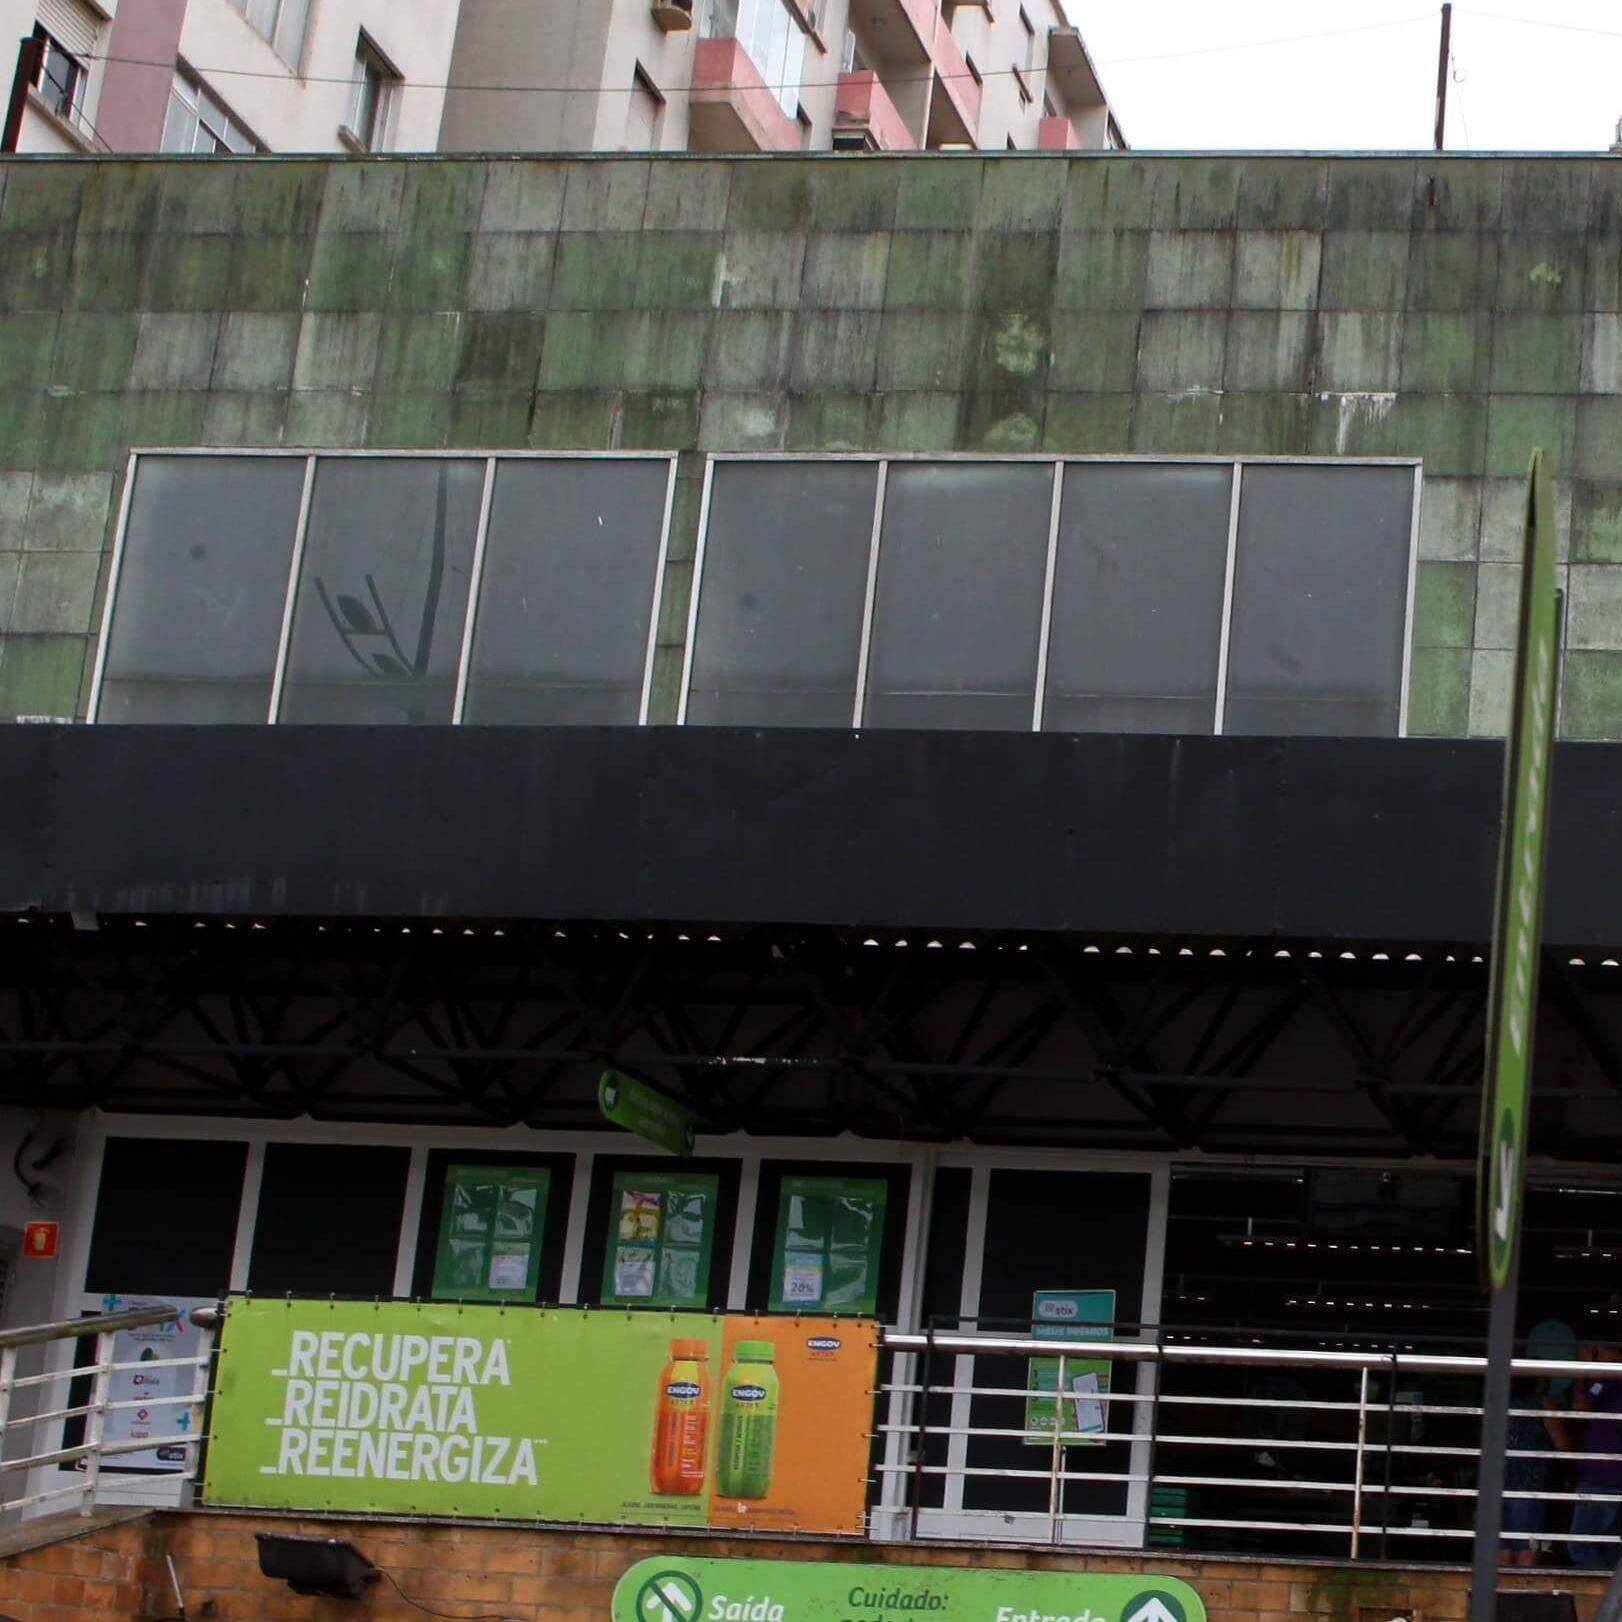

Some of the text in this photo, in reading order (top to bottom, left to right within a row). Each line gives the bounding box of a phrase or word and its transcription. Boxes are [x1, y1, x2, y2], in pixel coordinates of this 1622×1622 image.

[807, 1340, 841, 1349] ENGOV
[667, 1386, 700, 1396] ENGOV
[733, 1389, 766, 1399] ENGOV
[848, 1587, 949, 1610] Cuidado:
[708, 1595, 785, 1622] Saída
